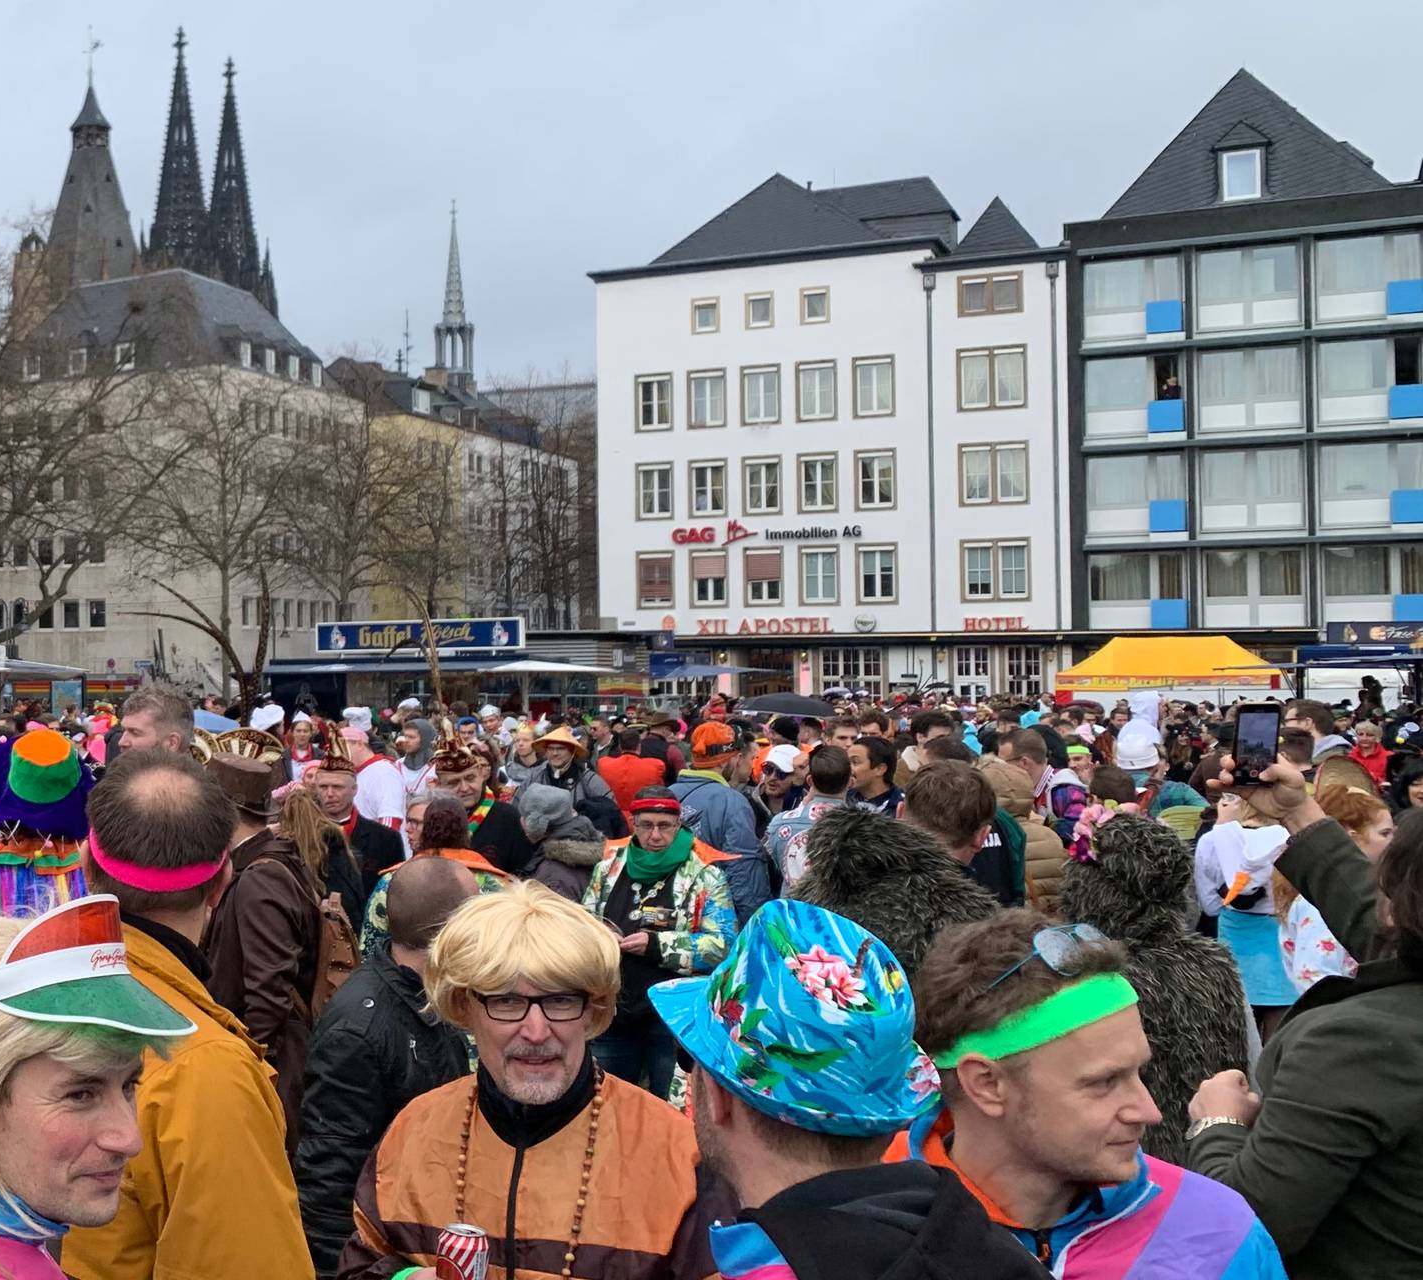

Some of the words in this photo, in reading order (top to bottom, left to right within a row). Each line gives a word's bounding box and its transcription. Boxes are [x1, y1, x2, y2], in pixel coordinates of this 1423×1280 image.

[672, 526, 715, 545] GAG
[765, 526, 838, 540] Immobilien
[842, 525, 862, 538] AG
[697, 619, 728, 634] XII
[737, 617, 833, 634] APOSTEL
[963, 617, 1029, 632] HOTEL
[359, 625, 411, 647] Gaffel
